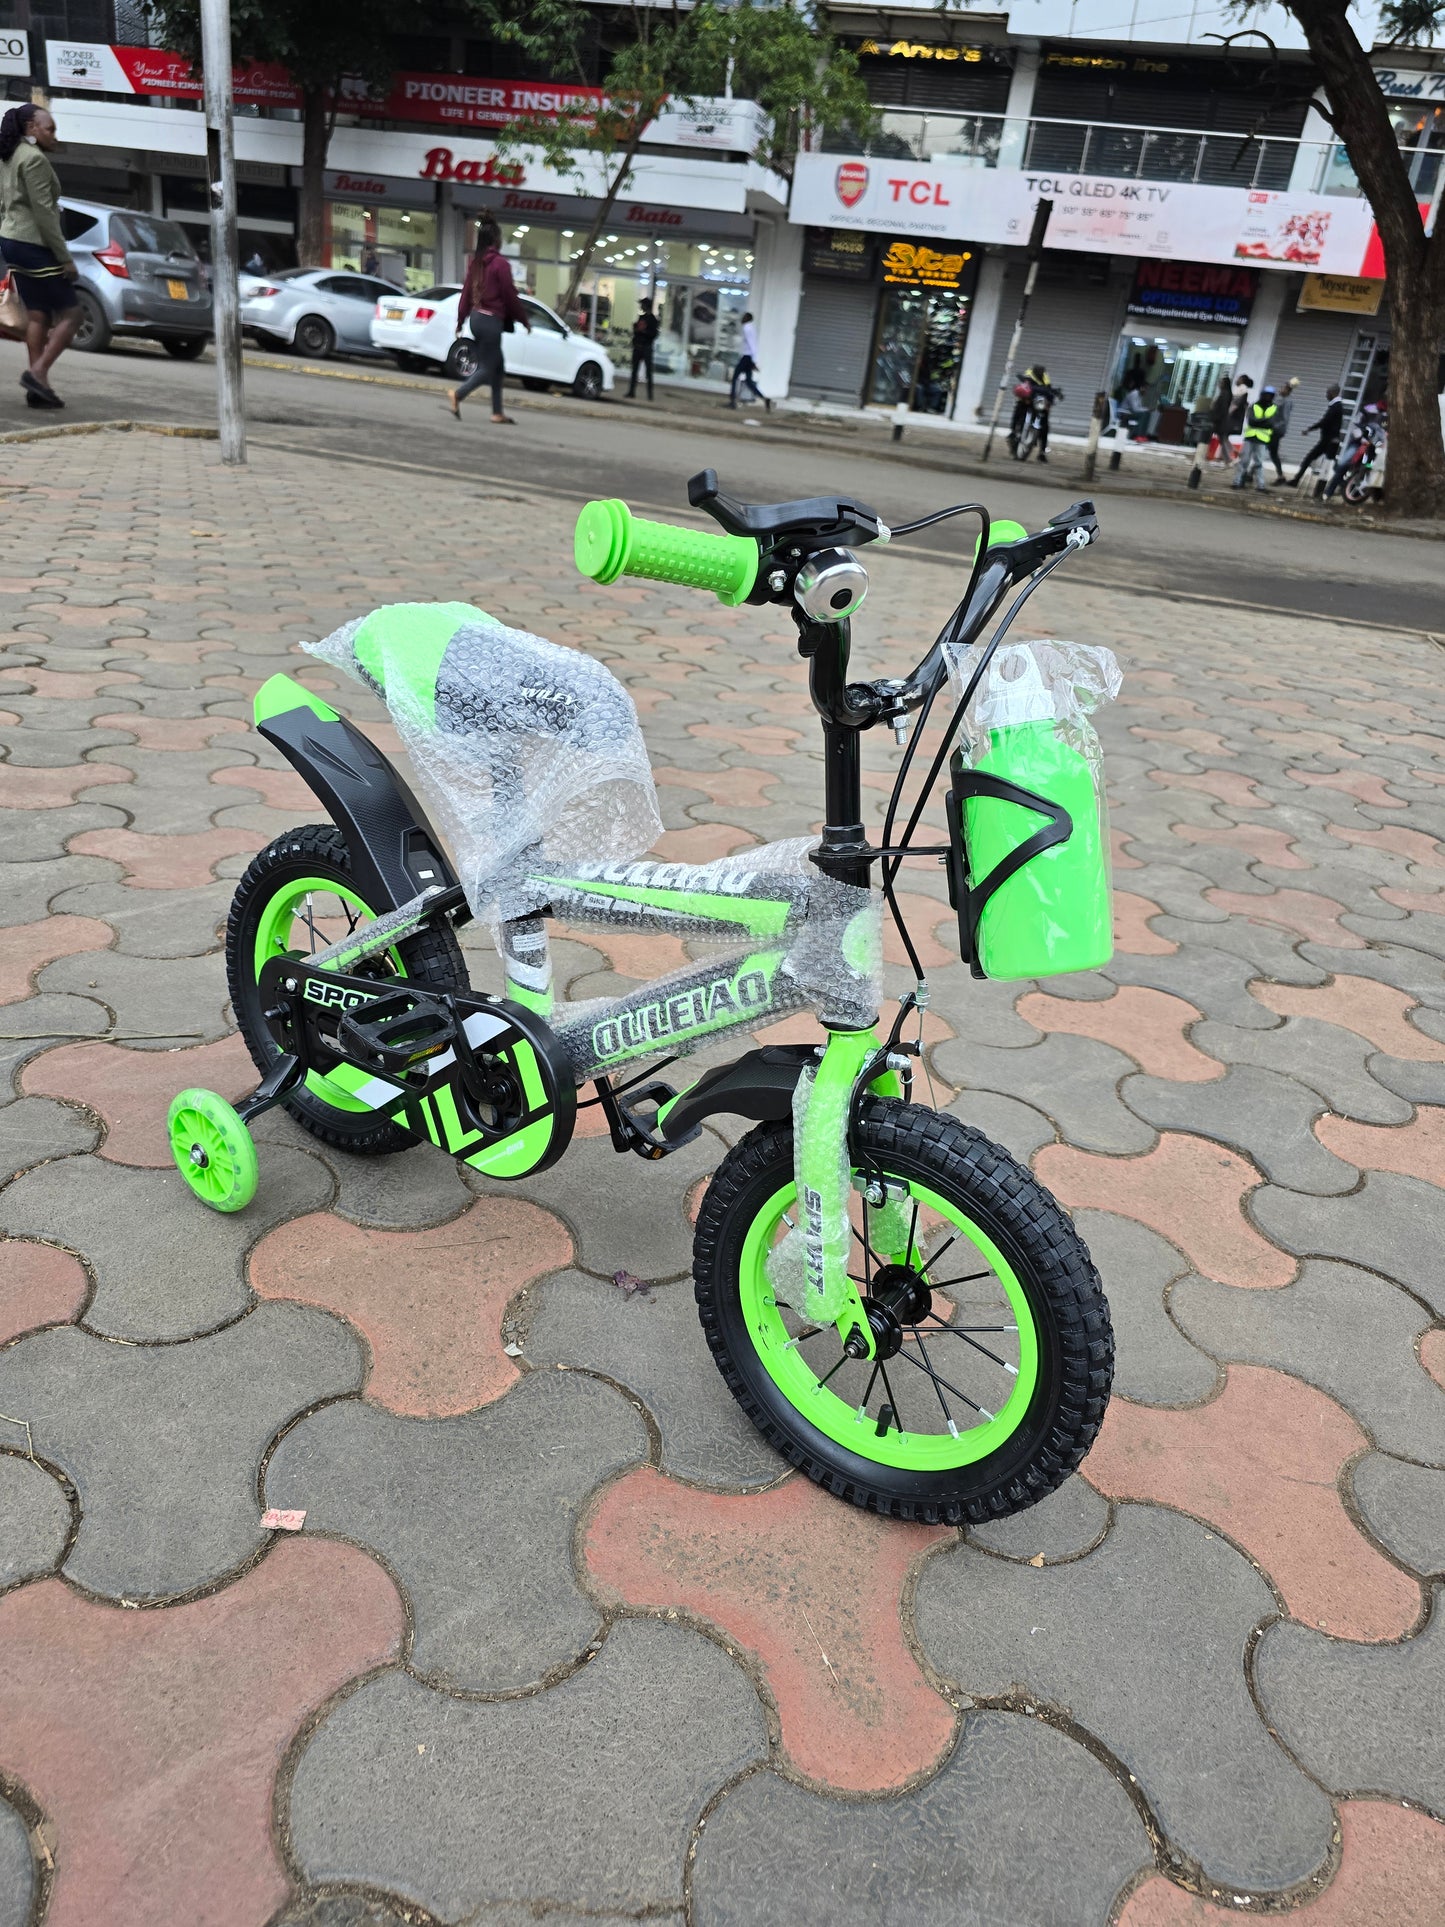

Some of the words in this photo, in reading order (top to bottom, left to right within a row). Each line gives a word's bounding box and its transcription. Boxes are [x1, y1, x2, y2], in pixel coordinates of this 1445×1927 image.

[405, 81, 506, 108] PIONEER
[419, 147, 527, 186] Bata
[334, 174, 387, 195] Bata
[888, 179, 951, 206] TCL
[1026, 178, 1063, 194] TCL
[1069, 180, 1116, 199] QLED
[1119, 185, 1142, 201] 4K
[1147, 187, 1172, 204] TV
[503, 193, 557, 213] Bata
[625, 205, 684, 226] Bata
[1137, 262, 1253, 298] NEEMA
[1128, 304, 1145, 314] Free
[520, 686, 578, 706] WILEY
[303, 978, 381, 1010] SPO
